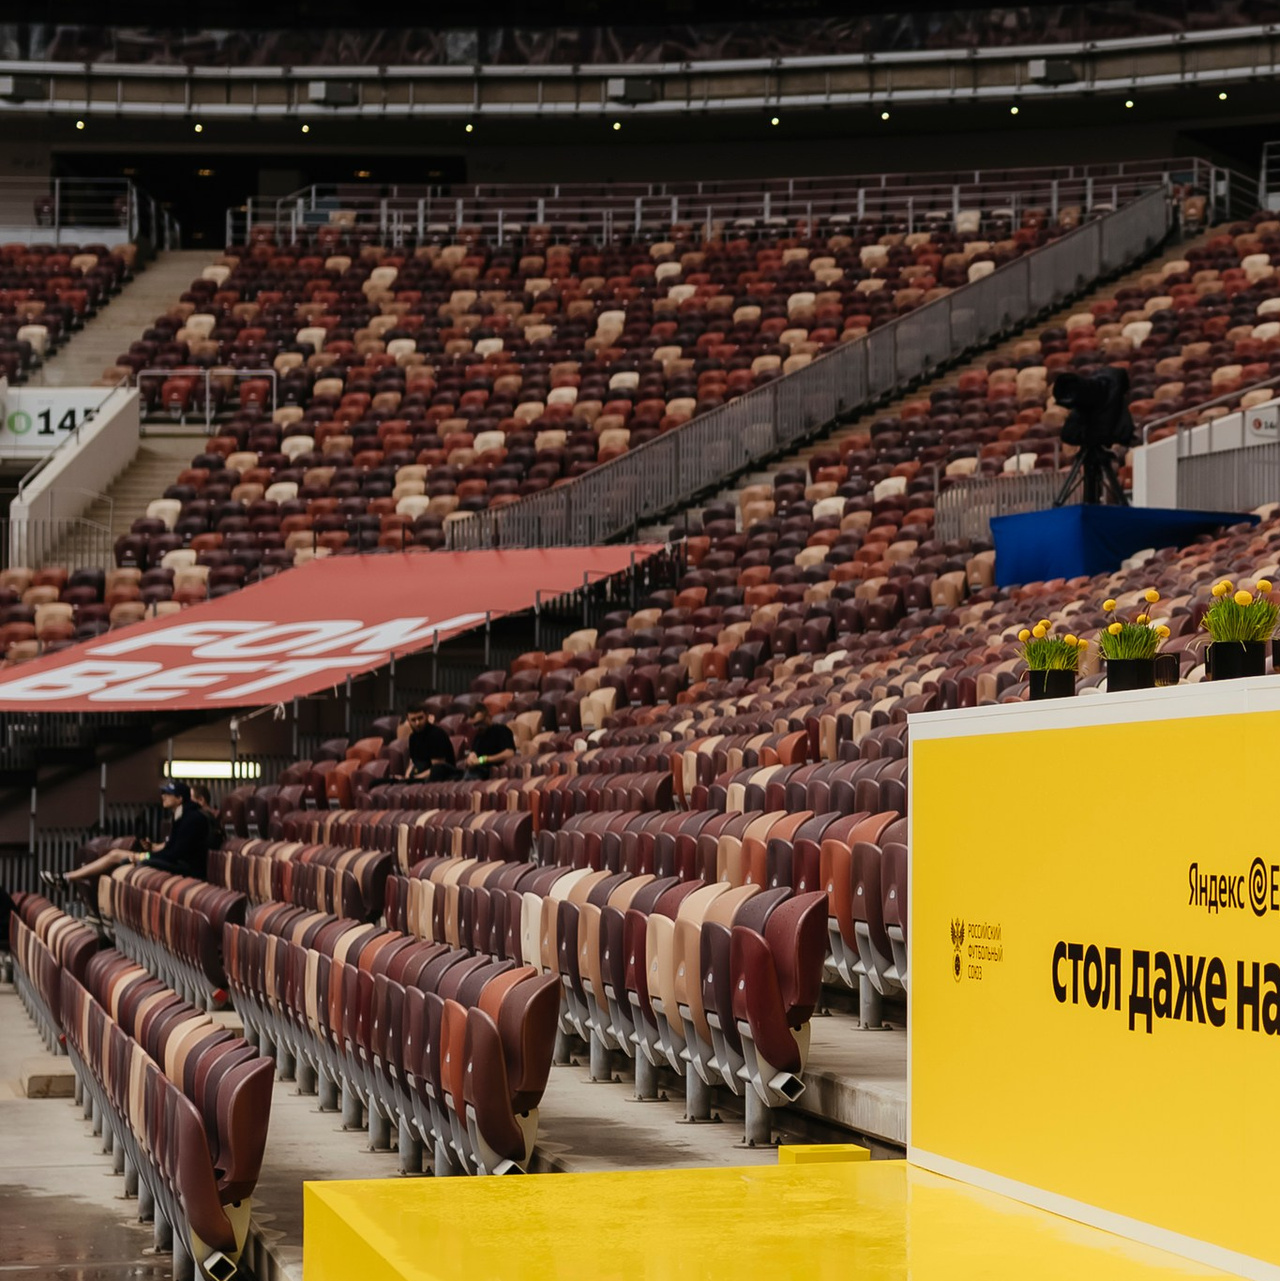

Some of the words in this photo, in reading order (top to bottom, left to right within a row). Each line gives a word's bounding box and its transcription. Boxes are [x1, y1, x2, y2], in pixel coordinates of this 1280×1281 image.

[85, 612, 487, 658] FON
[0, 653, 386, 702] BET
[1188, 862, 1245, 914] Яндекс
[1052, 940, 1122, 1011] стол
[1128, 949, 1228, 1034] даже
